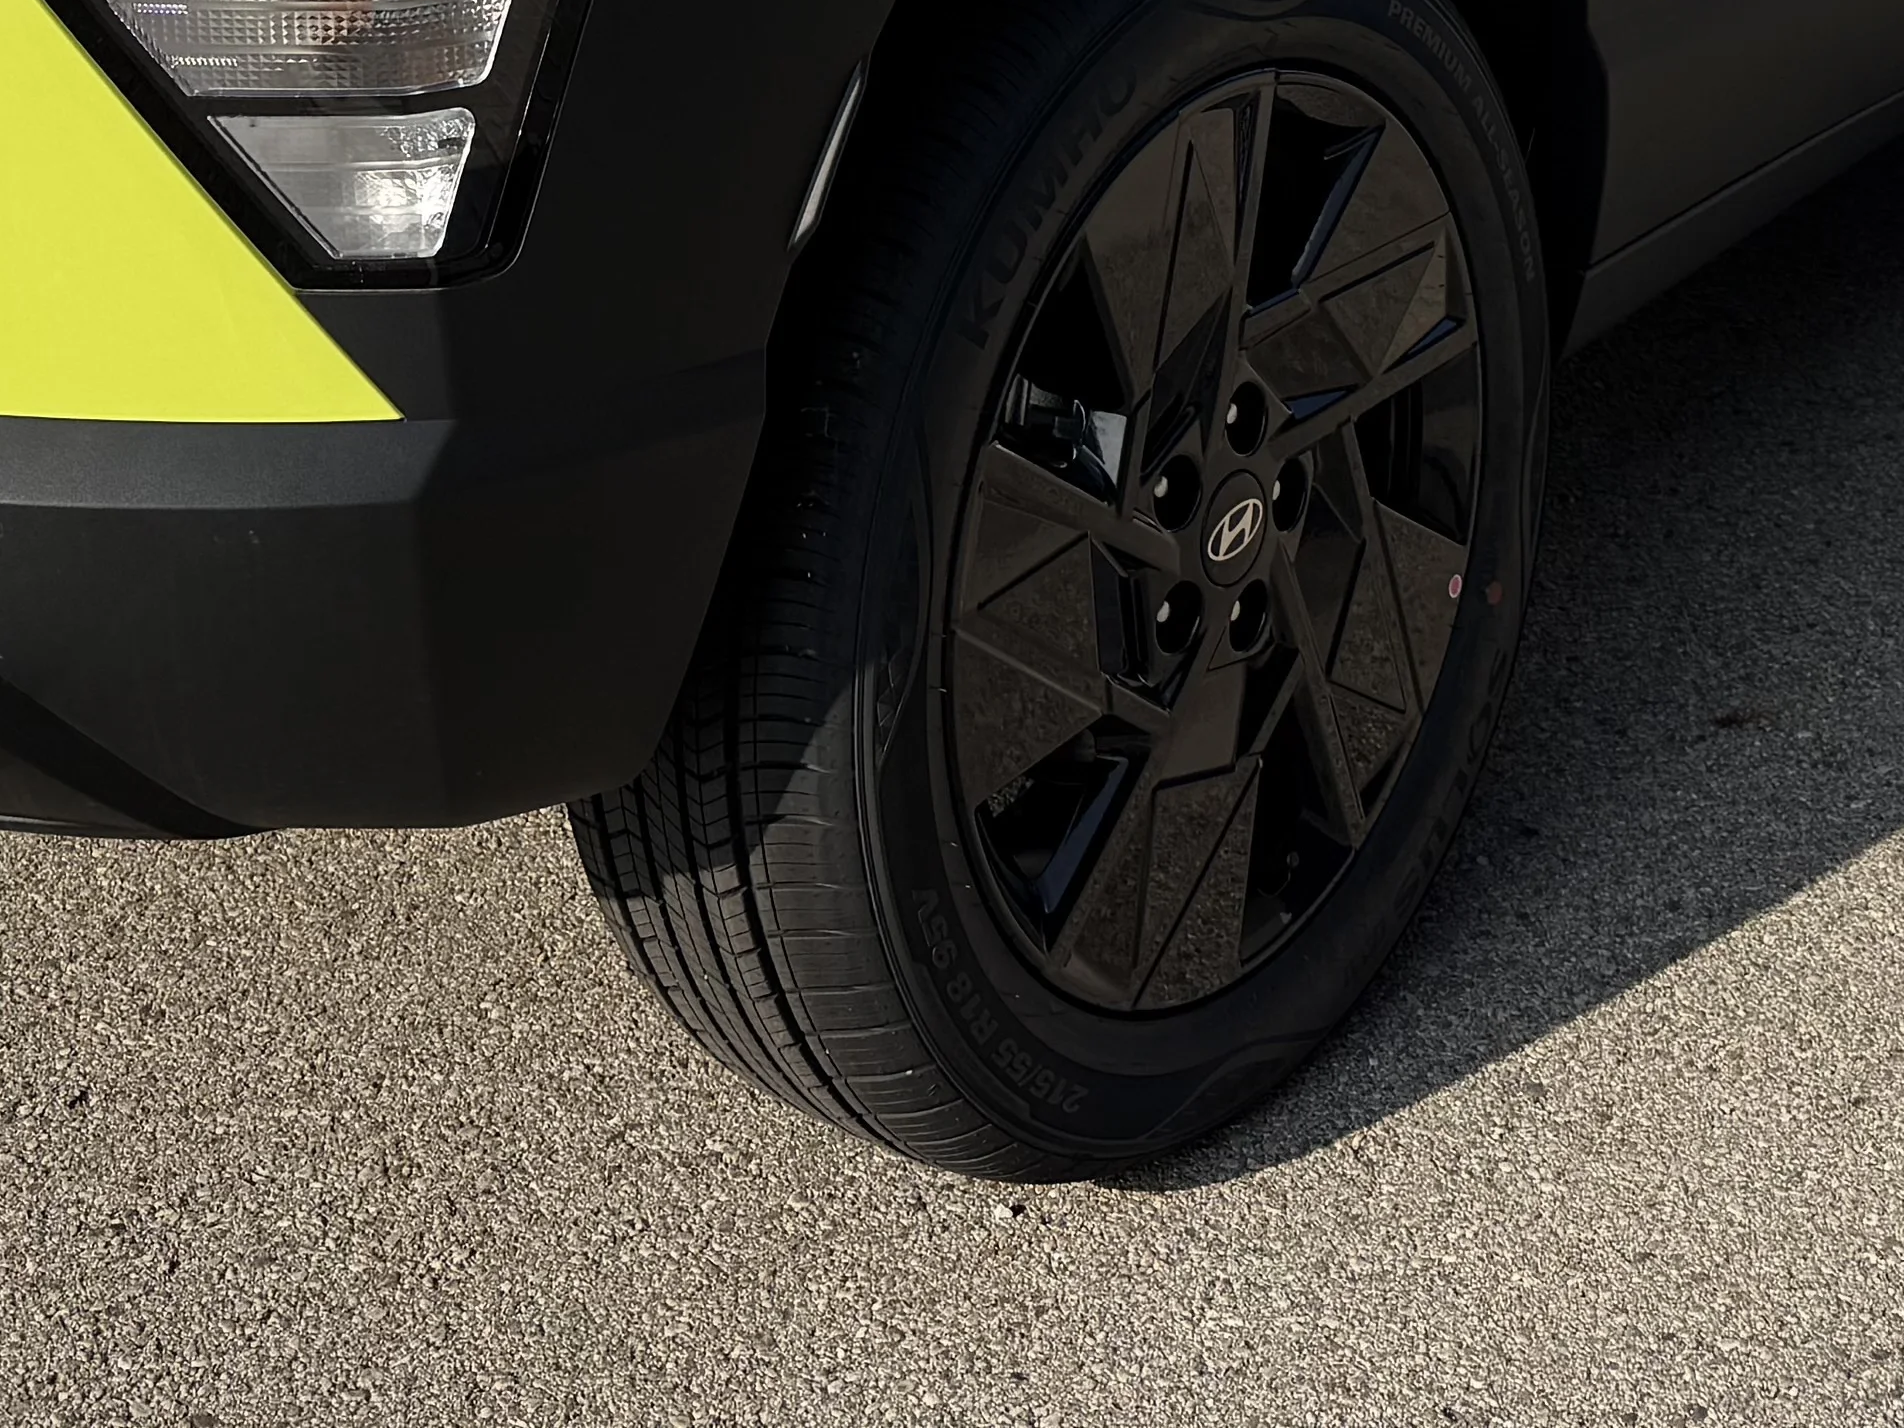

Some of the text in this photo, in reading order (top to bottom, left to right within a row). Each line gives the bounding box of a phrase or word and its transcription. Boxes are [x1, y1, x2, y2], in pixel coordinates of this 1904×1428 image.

[956, 63, 1138, 350] KUMHO
[1472, 95, 1536, 283] ALL-SEASON
[946, 971, 1000, 1045] R18
[990, 1037, 1090, 1114] 215/55
